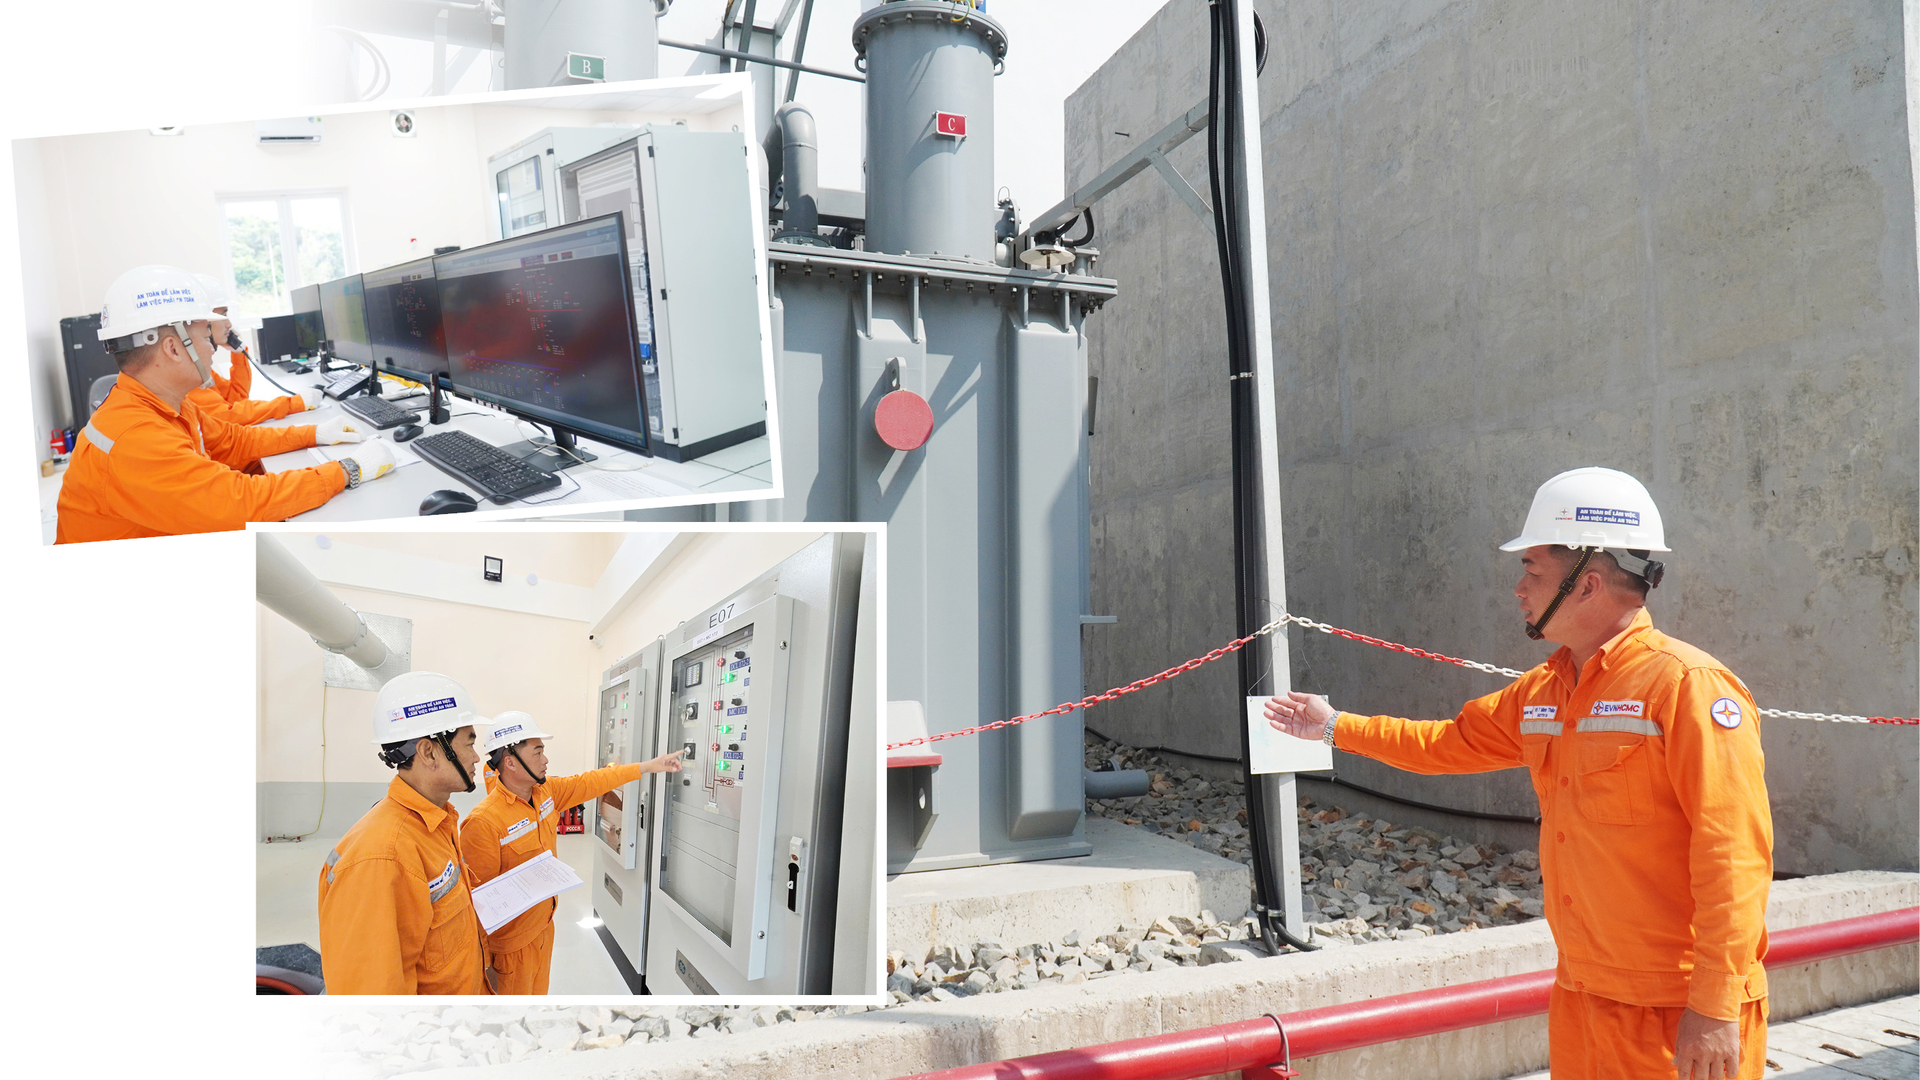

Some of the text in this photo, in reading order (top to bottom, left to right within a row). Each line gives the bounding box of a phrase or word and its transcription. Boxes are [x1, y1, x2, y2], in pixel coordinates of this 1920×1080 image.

[582, 59, 591, 74] B
[948, 117, 955, 131] C
[710, 603, 735, 628] E07
[1604, 704, 1640, 713] EVNHCMC
